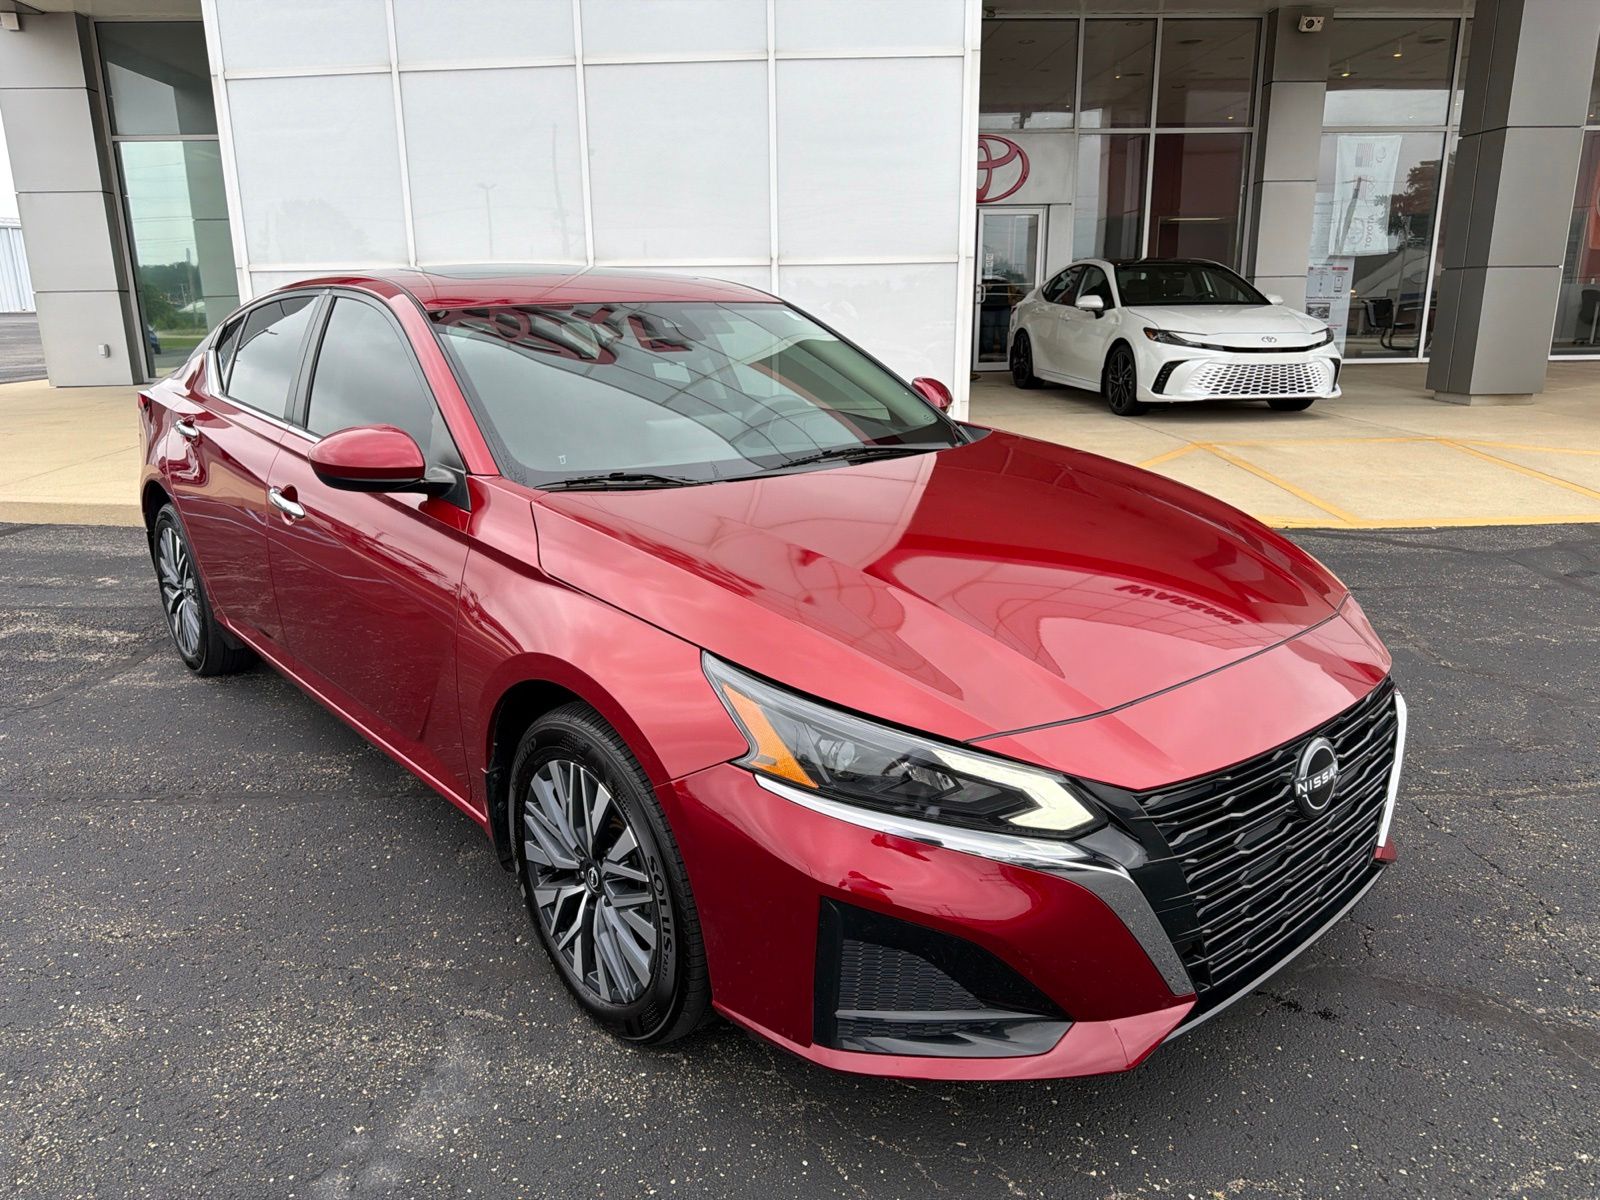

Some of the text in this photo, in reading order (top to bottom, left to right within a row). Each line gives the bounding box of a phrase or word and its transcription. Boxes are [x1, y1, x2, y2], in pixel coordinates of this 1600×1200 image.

[1364, 214, 1375, 248] TOYOTA
[1297, 767, 1337, 795] NISSA
[648, 855, 672, 954] SOLUS
